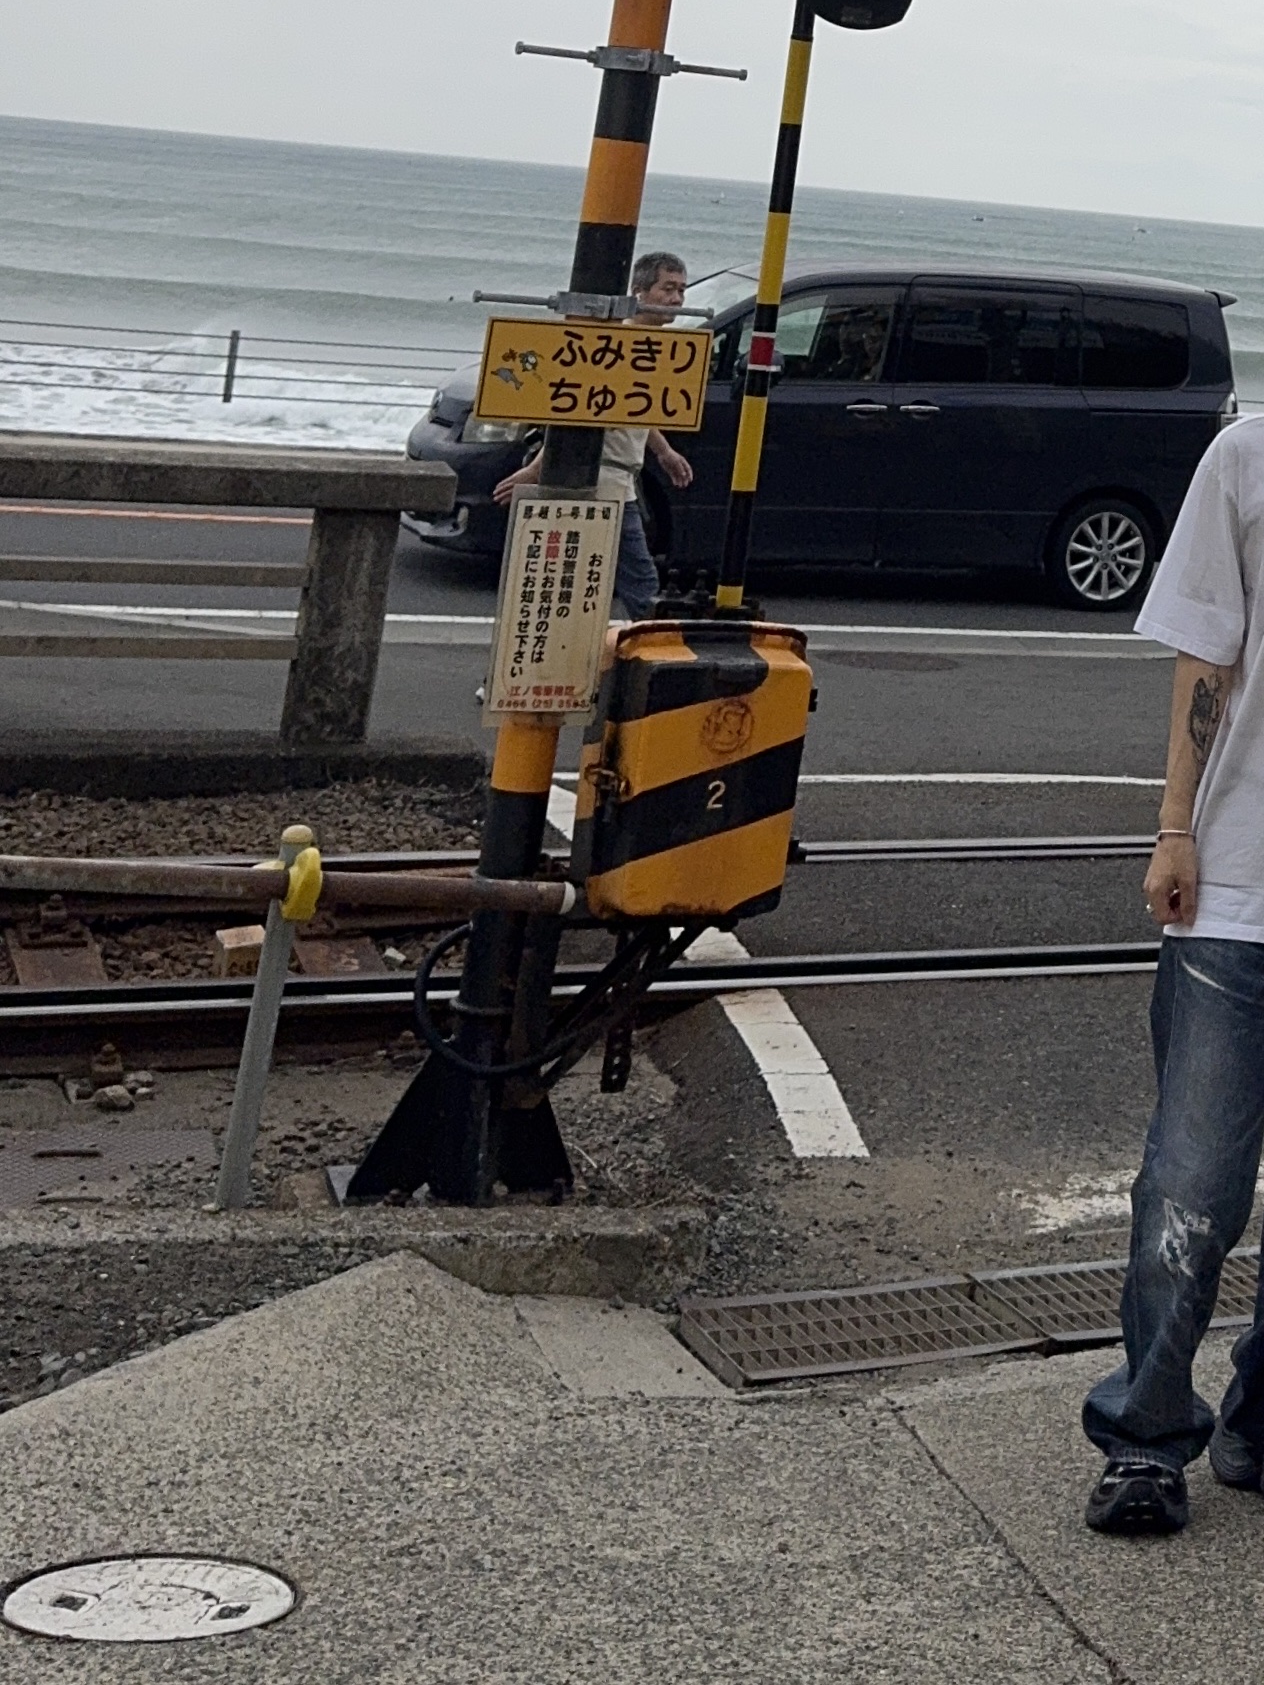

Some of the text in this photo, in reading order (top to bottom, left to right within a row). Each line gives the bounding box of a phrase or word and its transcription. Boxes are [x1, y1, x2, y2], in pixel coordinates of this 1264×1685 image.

[552, 330, 697, 374] ふみきり
[549, 378, 693, 418] ちゅうい
[556, 531, 581, 619] 踏切警報機の
[583, 553, 603, 613] おねがい
[510, 530, 543, 678] 下記にお知らせ下さい
[706, 780, 726, 809] 2
